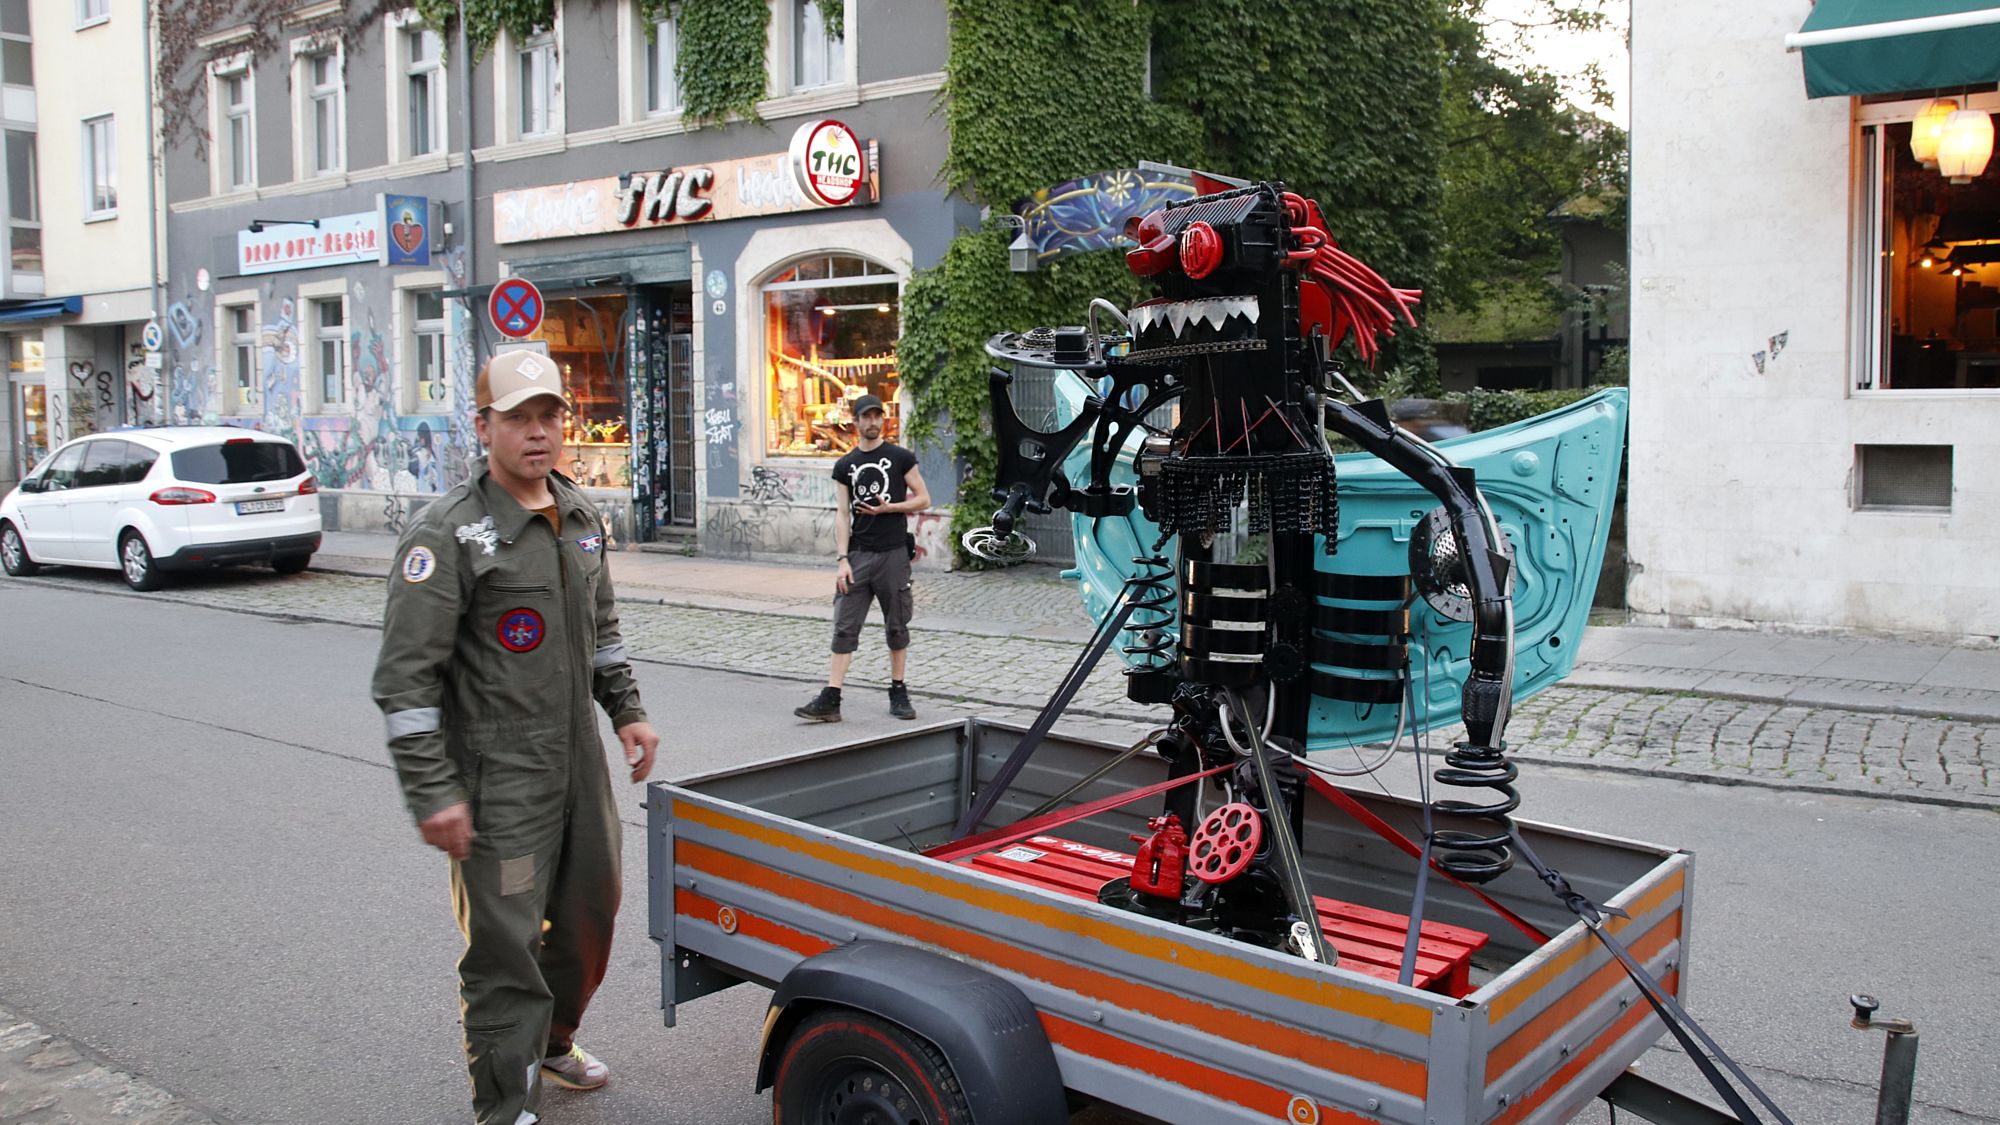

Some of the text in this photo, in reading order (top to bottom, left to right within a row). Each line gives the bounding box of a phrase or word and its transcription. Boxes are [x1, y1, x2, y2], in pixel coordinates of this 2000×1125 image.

[812, 150, 856, 176] THC
[614, 168, 714, 227] THC
[244, 242, 280, 263] DROP
